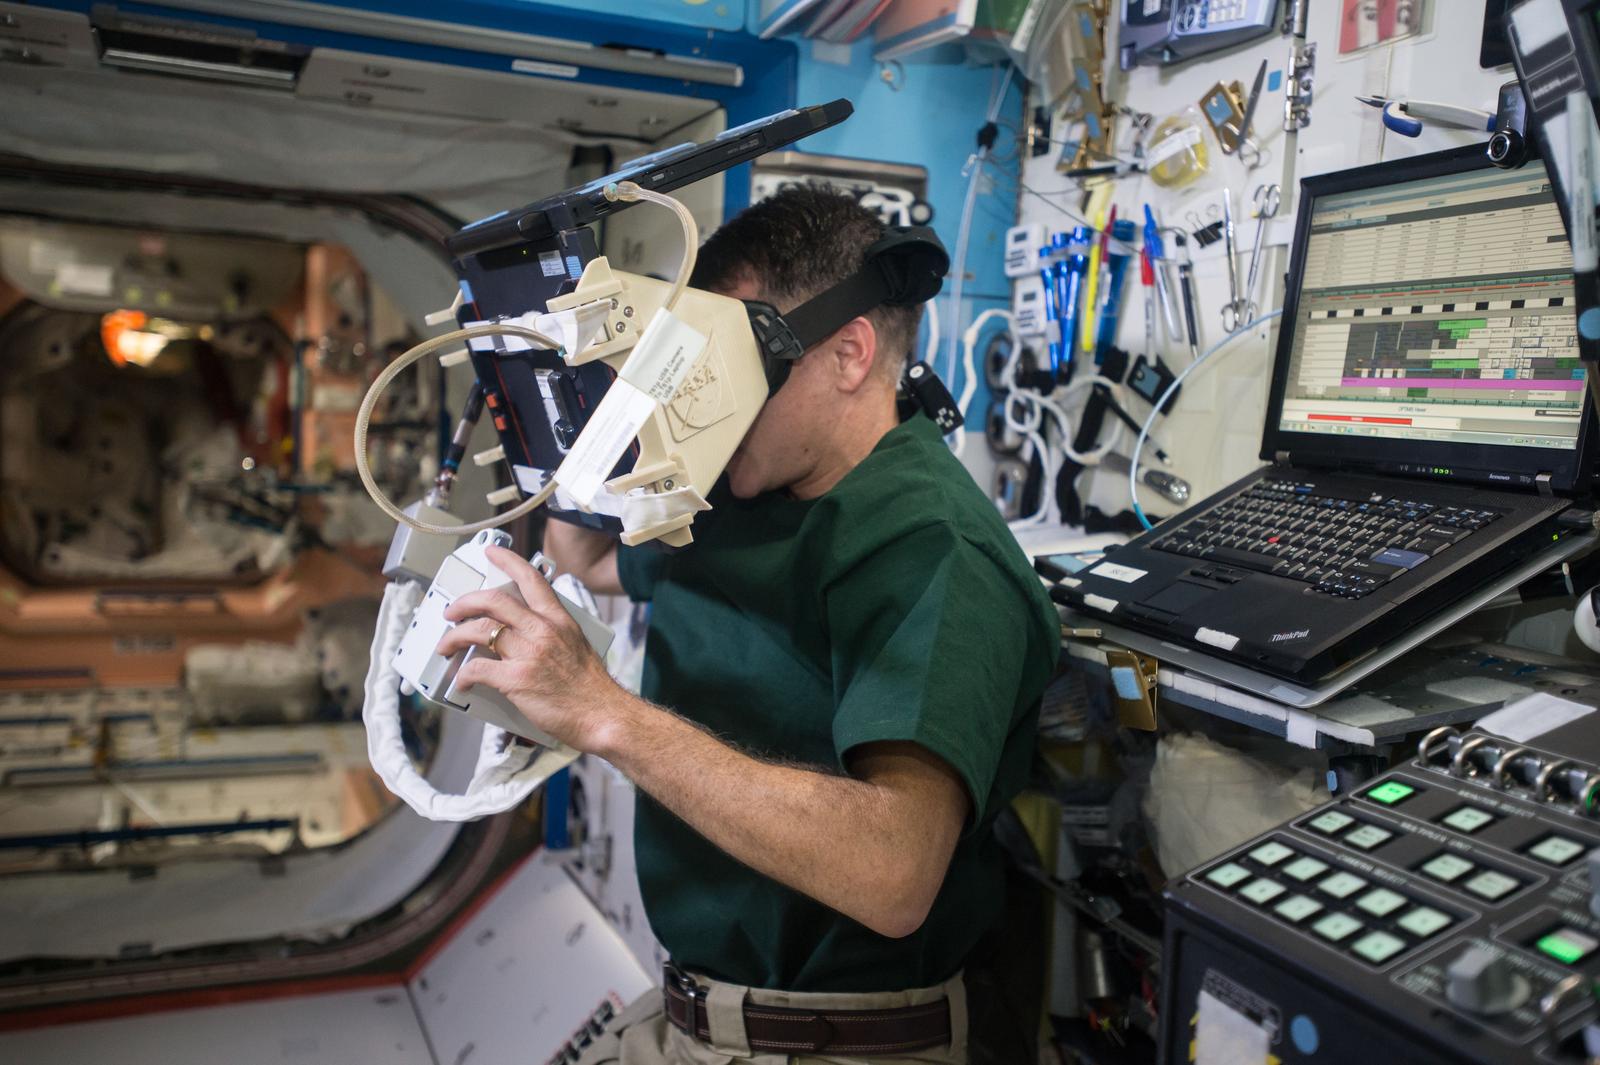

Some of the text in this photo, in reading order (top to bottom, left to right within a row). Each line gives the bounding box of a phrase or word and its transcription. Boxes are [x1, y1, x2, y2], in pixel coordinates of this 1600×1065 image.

[659, 367, 669, 381] USB
[667, 346, 684, 367] Camera
[669, 356, 685, 377] Laptop
[1271, 629, 1310, 643] ThinkPad
